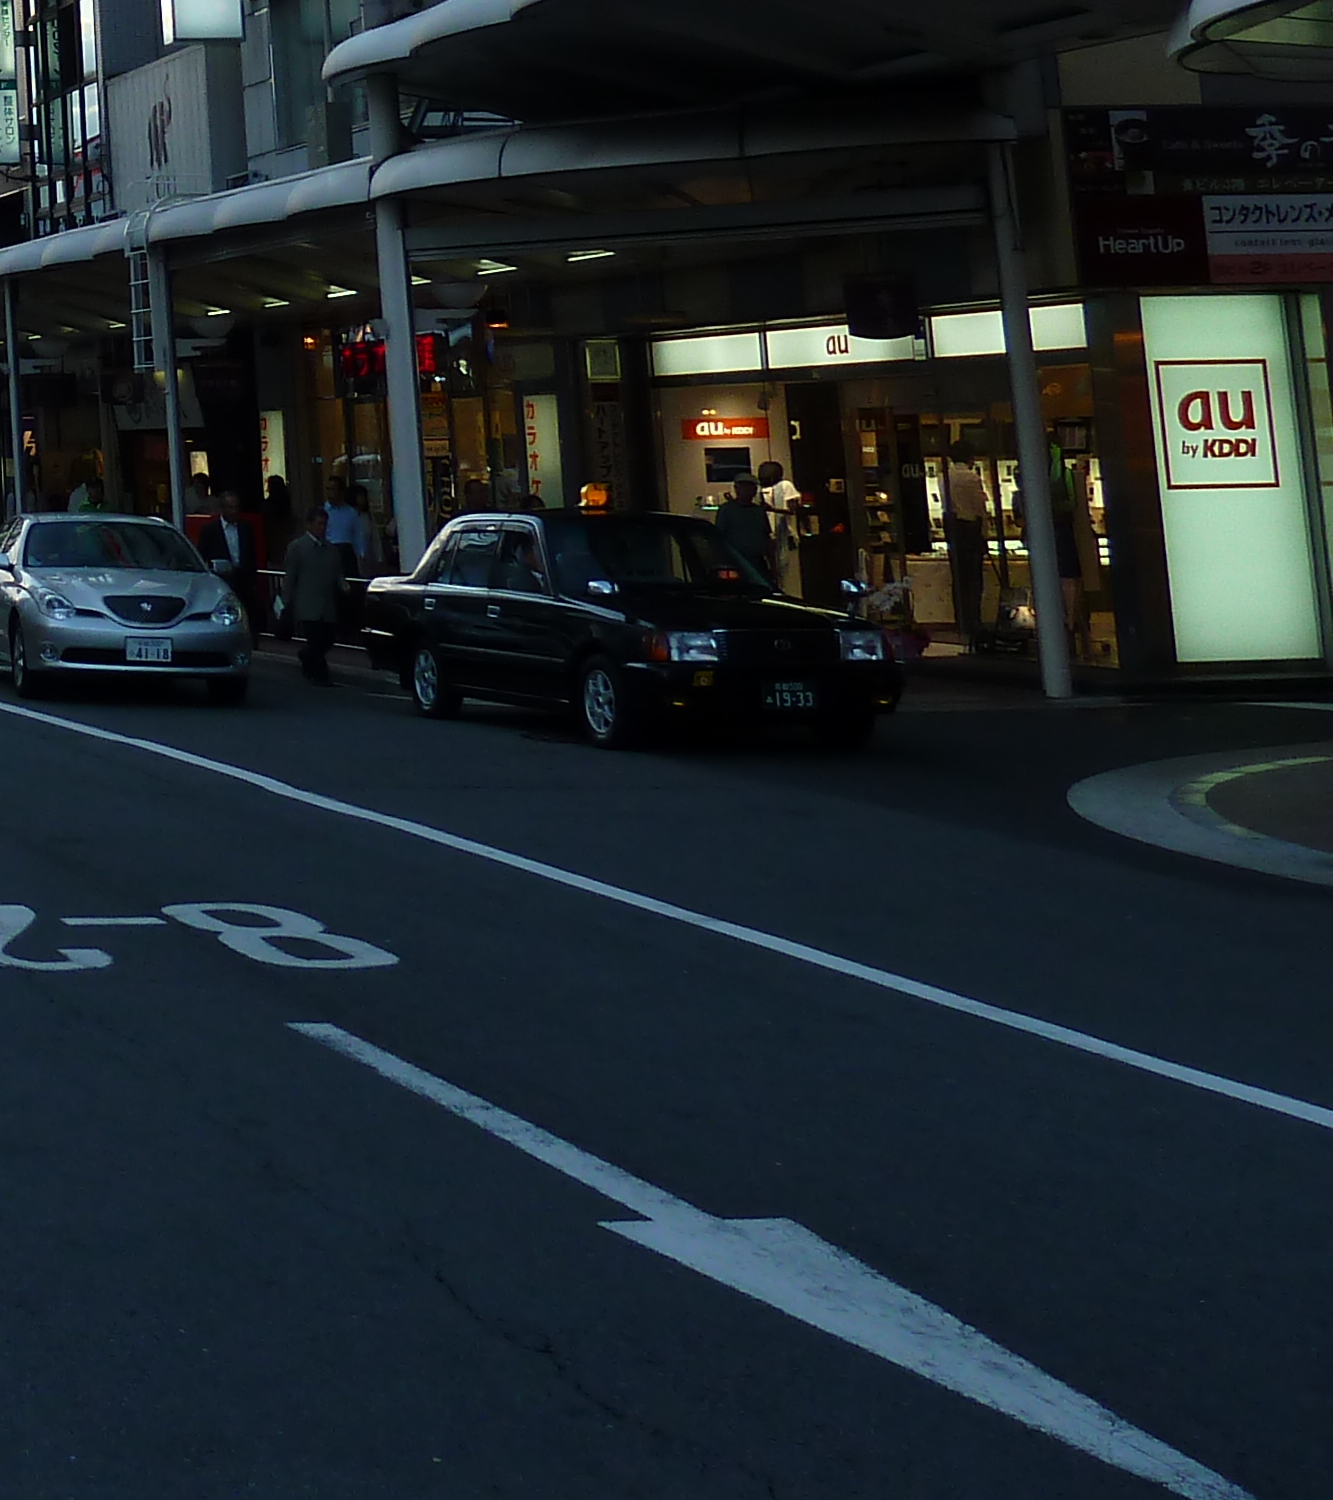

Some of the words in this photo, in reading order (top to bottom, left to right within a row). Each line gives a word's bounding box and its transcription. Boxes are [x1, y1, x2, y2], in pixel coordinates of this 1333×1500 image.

[826, 332, 850, 356] au
[1178, 388, 1256, 431] au
[695, 421, 723, 436] au
[525, 400, 541, 497] カラオケ
[1181, 438, 1199, 459] by
[1202, 438, 1257, 459] KDDI
[137, 648, 169, 660] 41-18
[775, 691, 813, 707] 19-33
